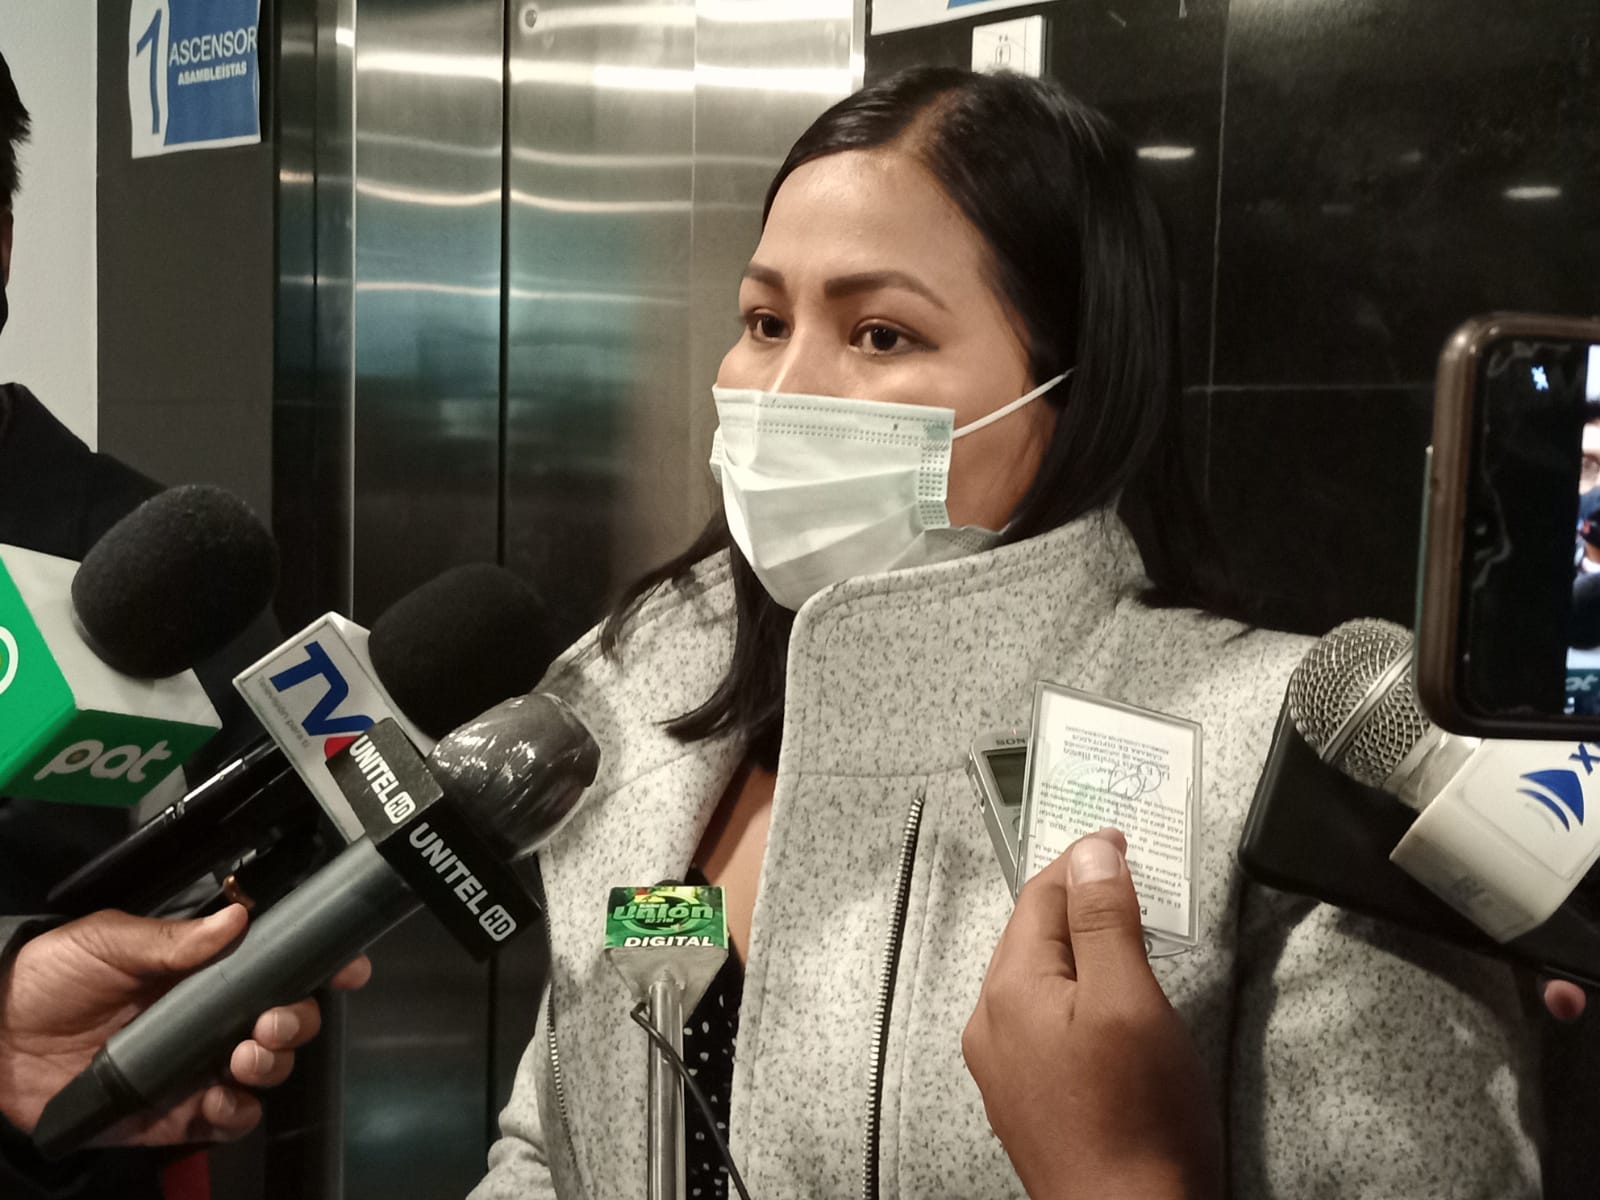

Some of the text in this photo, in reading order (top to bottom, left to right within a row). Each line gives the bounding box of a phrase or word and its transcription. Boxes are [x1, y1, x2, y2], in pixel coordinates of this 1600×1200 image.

[169, 26, 257, 67] ASCENSOR
[33, 739, 172, 783] pat
[996, 737, 1026, 746] SON
[349, 734, 401, 804] UNITEL
[409, 822, 489, 915] UNITEL
[624, 936, 714, 947] DIGITAL
